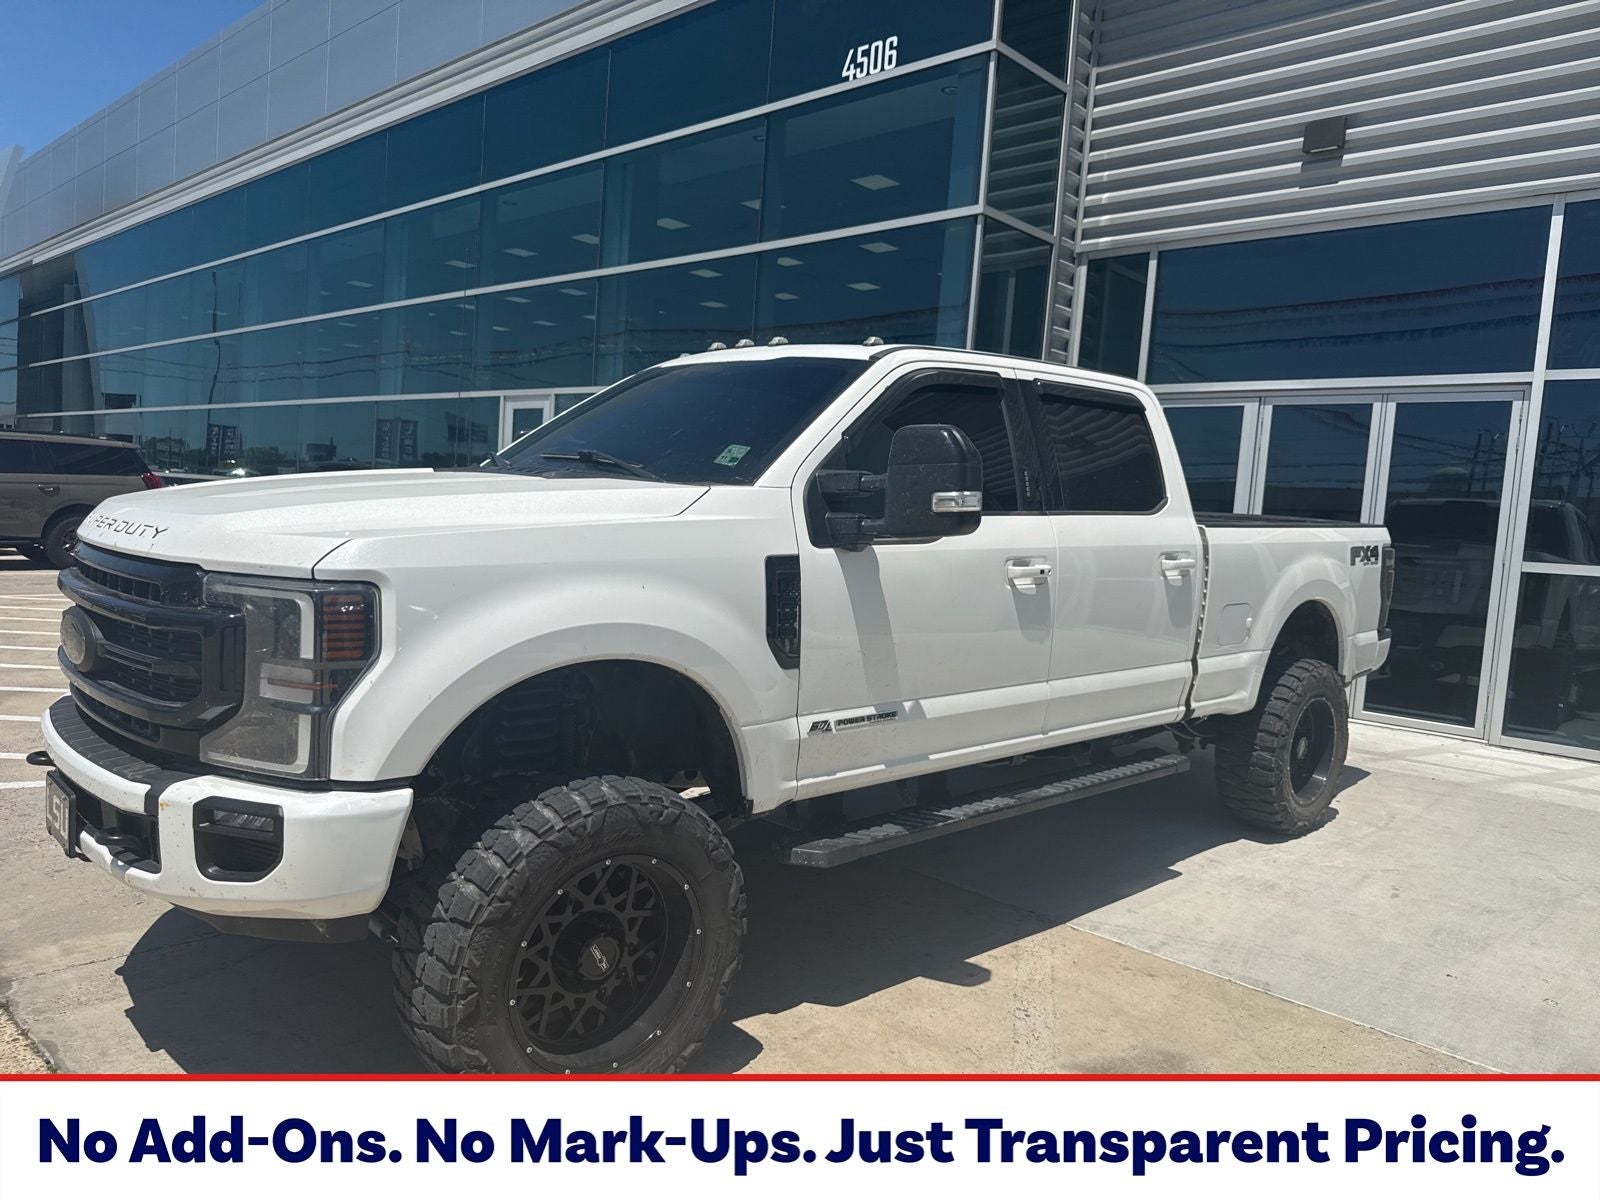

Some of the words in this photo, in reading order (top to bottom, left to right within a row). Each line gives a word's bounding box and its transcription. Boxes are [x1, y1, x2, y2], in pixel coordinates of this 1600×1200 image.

[841, 35, 898, 82] 4506
[113, 519, 168, 539] DUTY
[1350, 545, 1379, 567] FX4
[837, 716, 865, 727] POWER
[866, 711, 897, 721] STROKE
